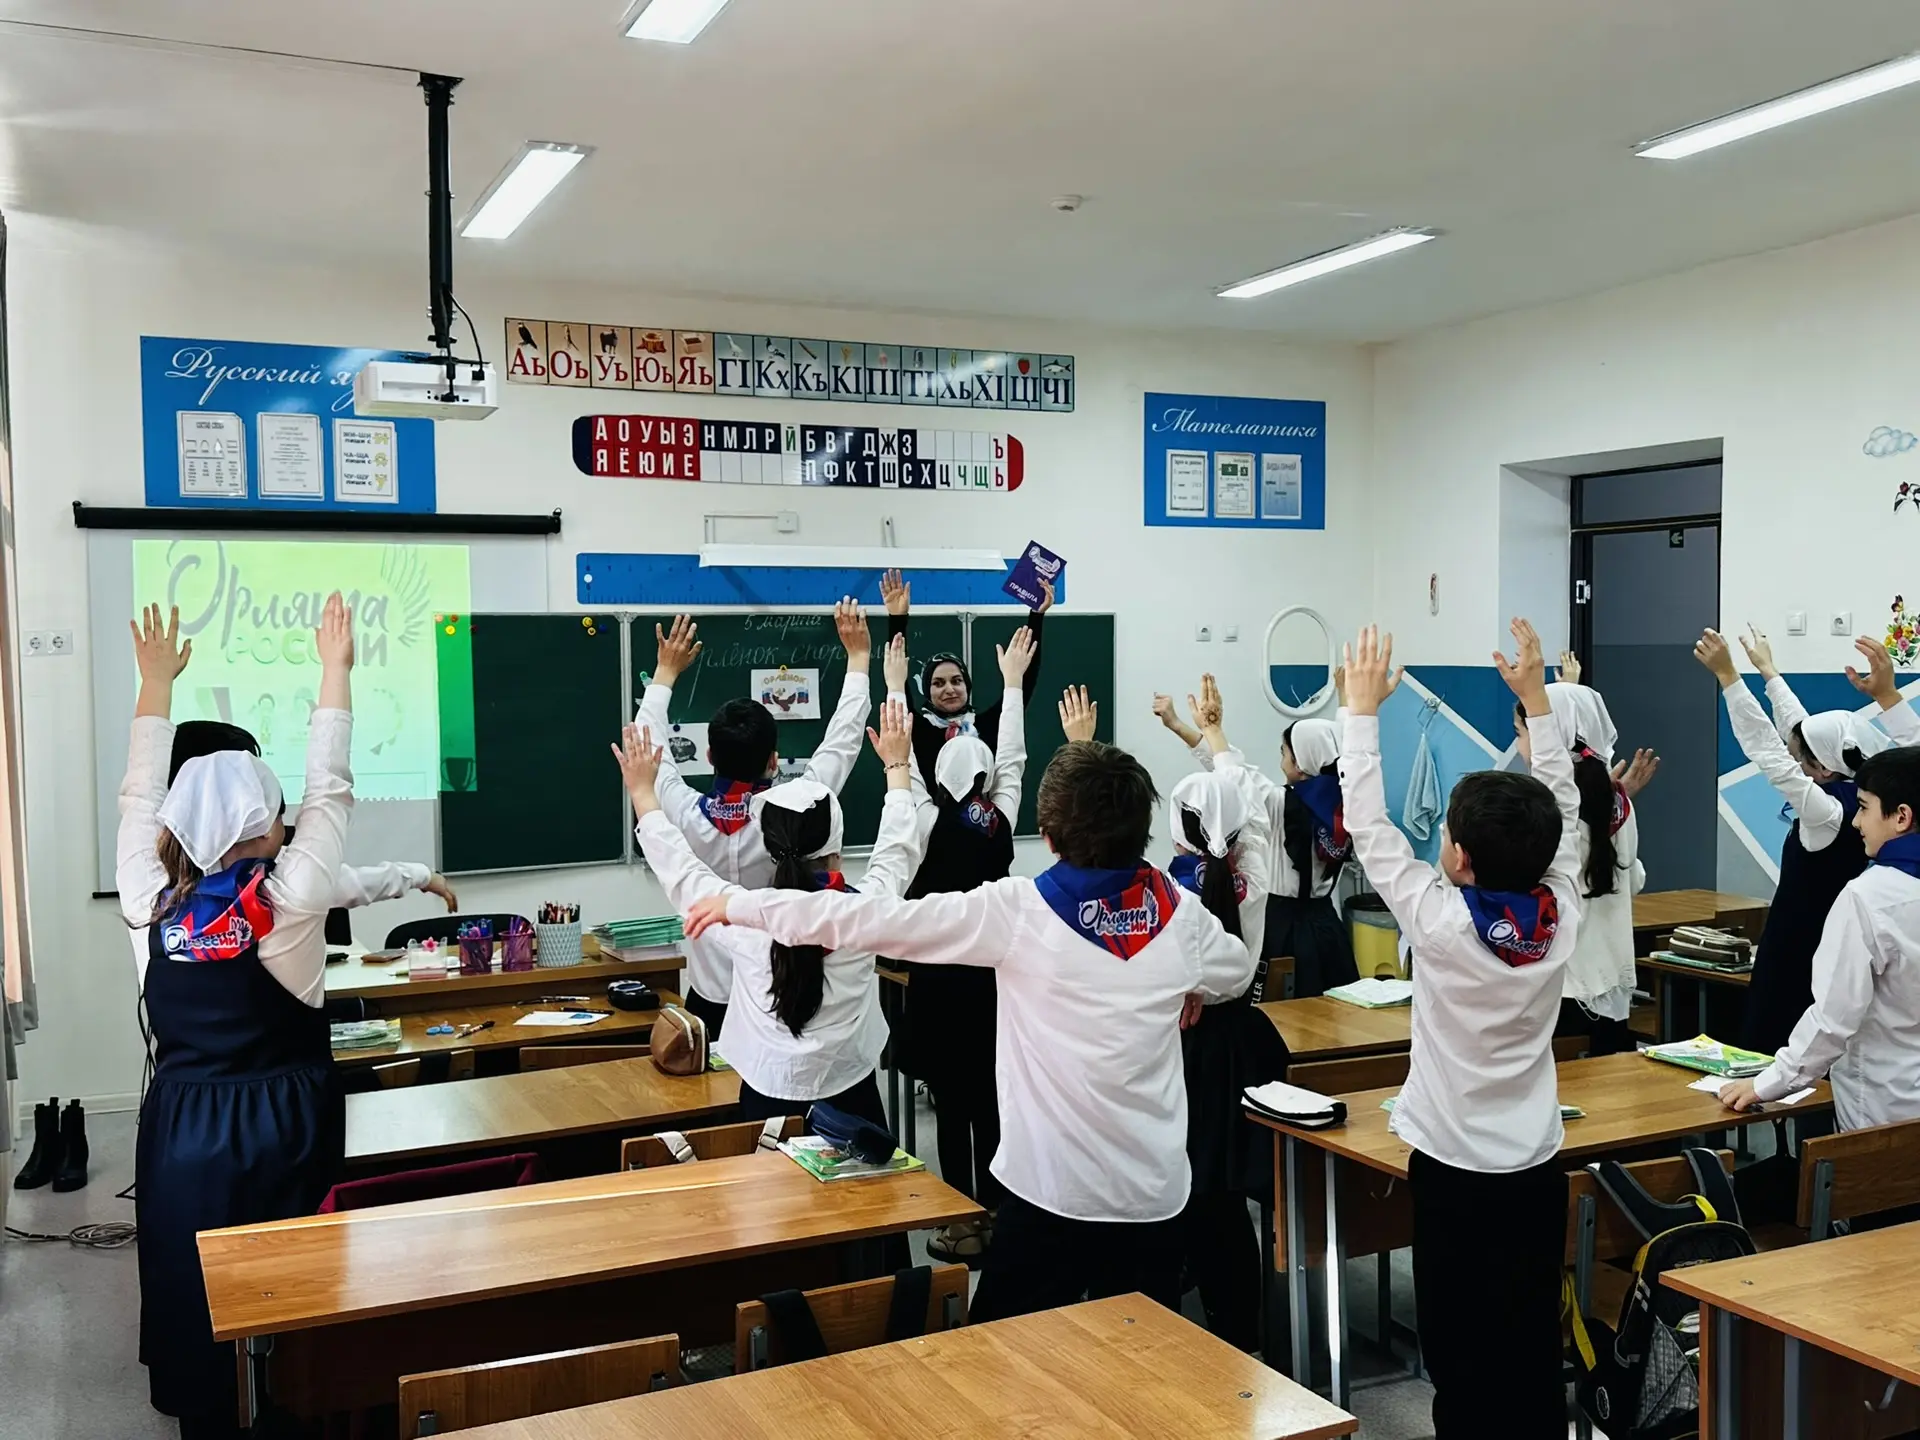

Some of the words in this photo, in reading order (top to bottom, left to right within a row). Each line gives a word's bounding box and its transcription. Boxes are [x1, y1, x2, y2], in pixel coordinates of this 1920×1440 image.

[165, 346, 323, 406] Русский
[1151, 407, 1318, 438] Математика
[1009, 582, 1038, 603] ПРАВИЛА
[1080, 899, 1148, 930] Орлята
